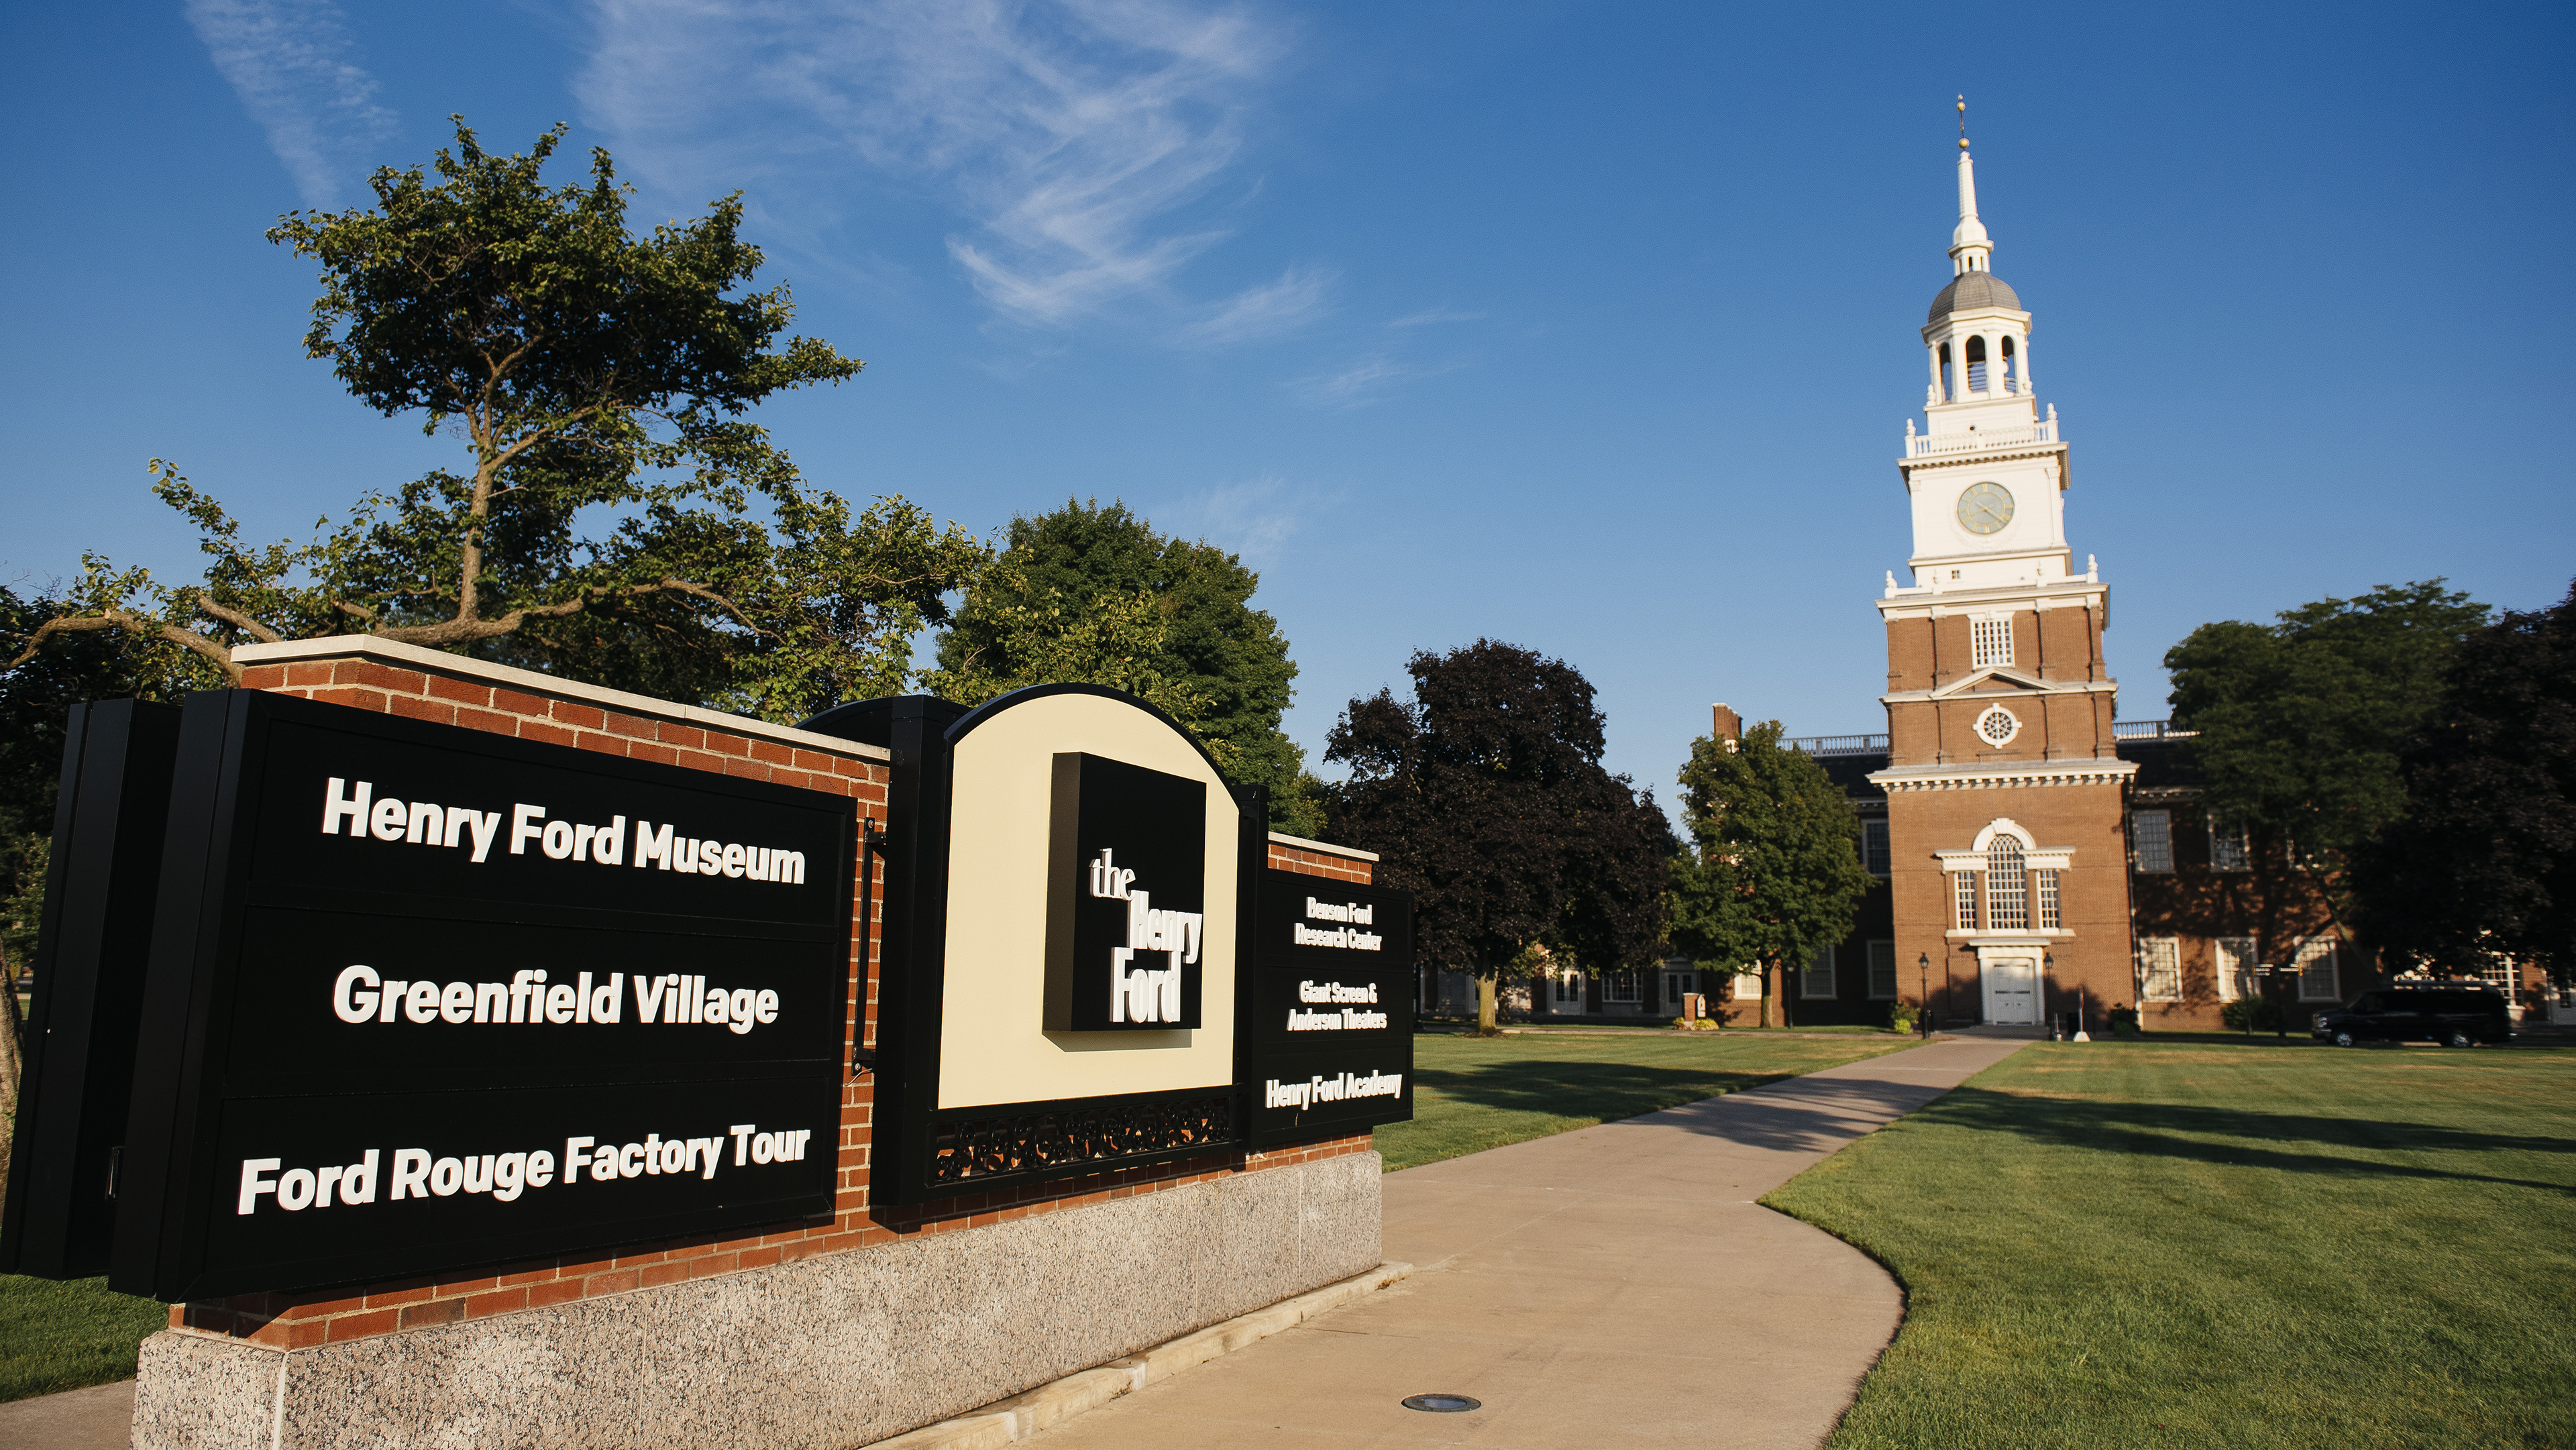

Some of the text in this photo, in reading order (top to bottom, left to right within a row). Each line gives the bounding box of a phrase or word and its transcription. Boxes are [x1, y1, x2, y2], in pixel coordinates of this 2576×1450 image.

[322, 777, 806, 885] Henry Ford Museum
[1089, 847, 1136, 901] the
[1127, 889, 1203, 964] Henry
[1294, 922, 1382, 951] Research Center
[1306, 896, 1373, 925] Benson Ford
[333, 964, 780, 1035] Greenfield Village
[1110, 946, 1181, 1023] Ford
[1299, 980, 1378, 1003] Giant Screen &
[1287, 1007, 1387, 1031] Anderson Theaters
[1265, 1069, 1403, 1111] Henry Ford Academy
[237, 1124, 811, 1216] Ford Rouge Factory Tour
